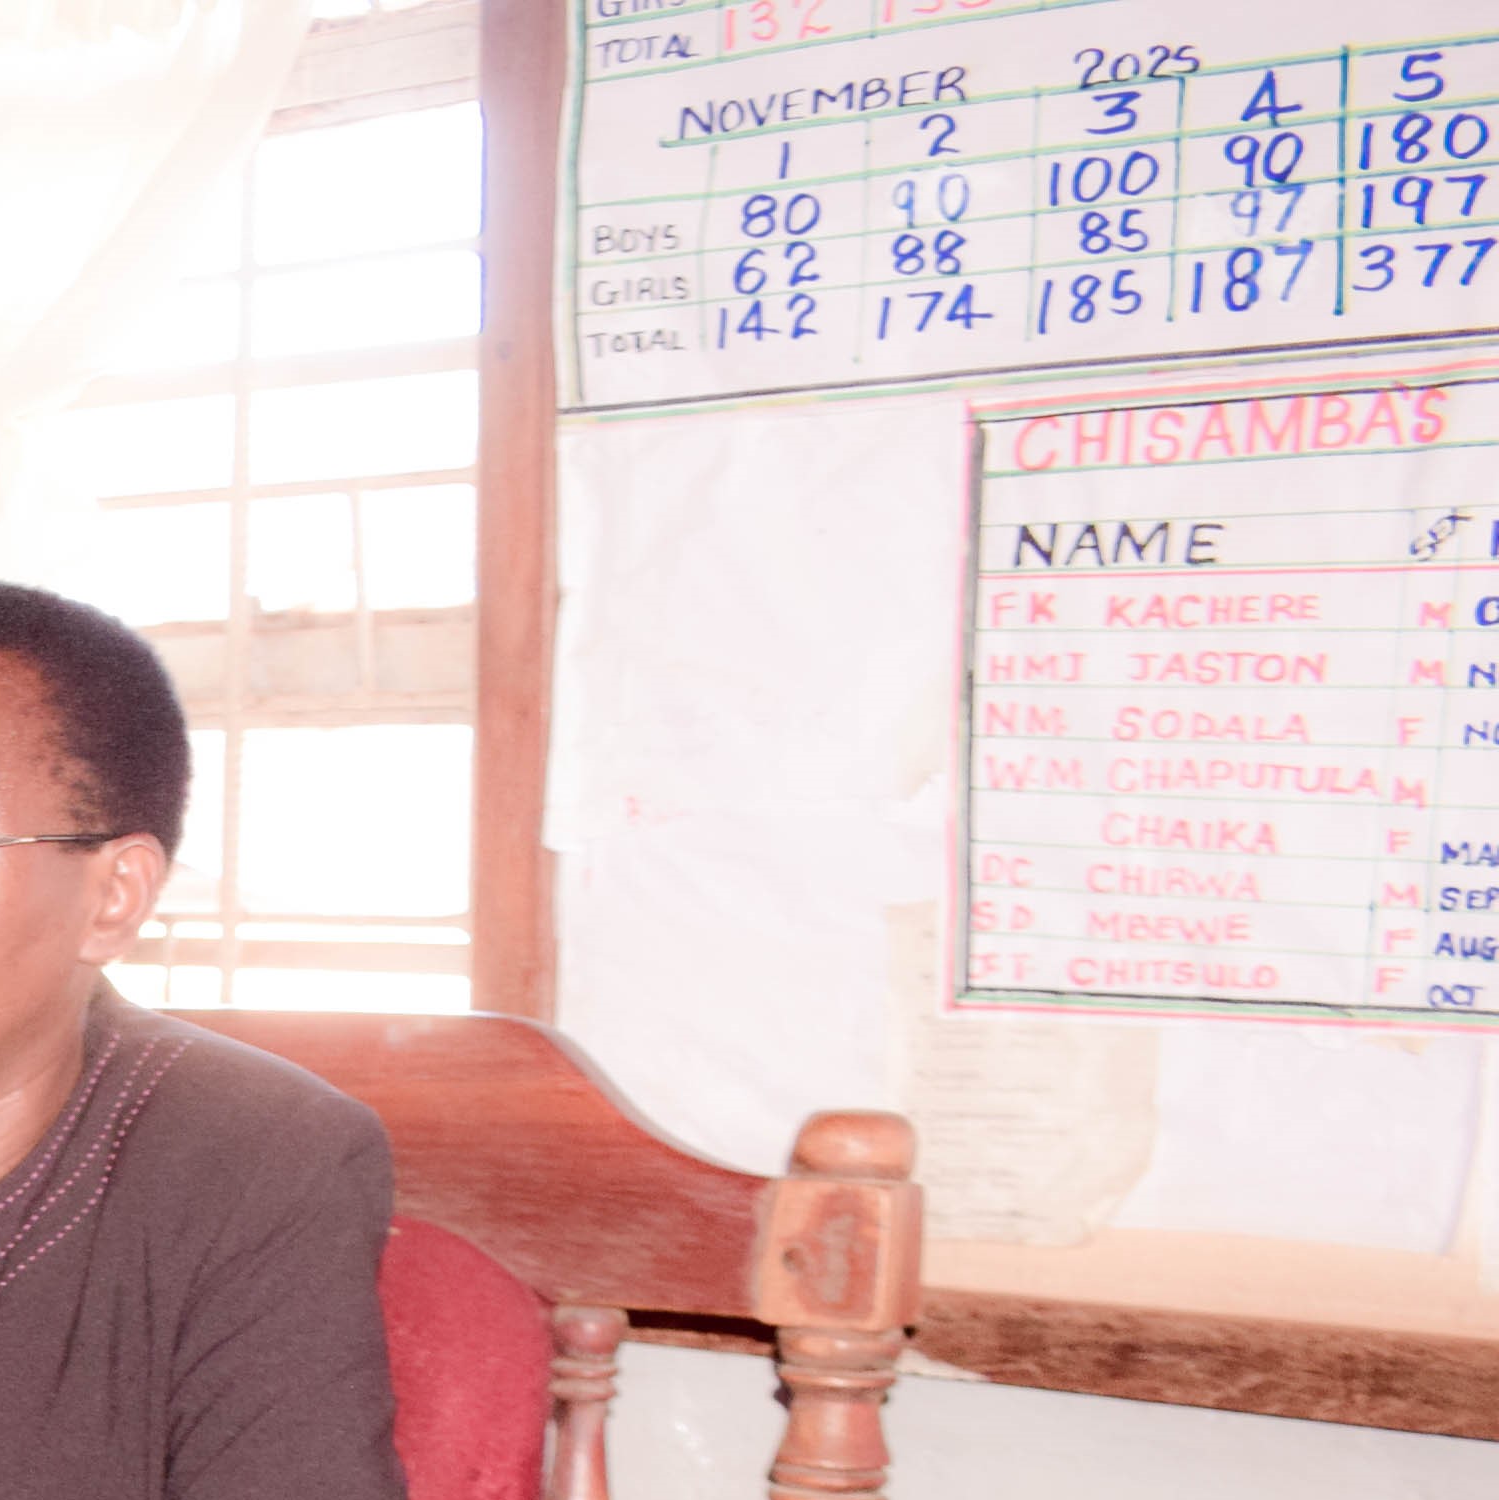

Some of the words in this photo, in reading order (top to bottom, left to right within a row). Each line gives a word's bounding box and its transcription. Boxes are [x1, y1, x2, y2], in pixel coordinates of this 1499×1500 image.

[595, 33, 699, 67] TOTAL
[679, 66, 968, 140] NOVEMBER
[1072, 44, 1201, 91] 2025
[778, 141, 791, 180] 1
[919, 113, 961, 158] 2
[1084, 90, 1144, 135] 3
[1239, 70, 1303, 129] 4
[1391, 51, 1446, 103] 5
[592, 223, 681, 256] BOYS
[741, 193, 822, 239] 80
[892, 173, 971, 230] 90
[1049, 150, 1160, 207] 100
[1223, 130, 1305, 187] 90
[1358, 111, 1491, 171] 180
[591, 276, 691, 307] GIRLS
[732, 240, 822, 296] 62
[890, 229, 968, 276] 88
[1078, 207, 1150, 255] 85
[1229, 182, 1307, 238] 97
[1360, 172, 1489, 230] 197
[587, 328, 688, 359] TOTAL
[716, 293, 819, 350] 142
[877, 283, 995, 341] 174
[1036, 268, 1144, 336] 185
[1189, 237, 1315, 315] 187
[1351, 236, 1499, 292] 377
[1012, 384, 1451, 472] CHISAMBA'S
[1012, 520, 1226, 568] NAME
[1103, 593, 1324, 629] KACHERE
[1417, 600, 1454, 629] M
[1128, 650, 1330, 687] JASTON
[1408, 657, 1447, 687] M
[1110, 705, 1315, 743] SODALA
[1395, 715, 1425, 747] F
[1105, 755, 1383, 797] CHAPUTULA
[1390, 775, 1429, 811] M
[1100, 808, 1282, 856] CHAIKA
[1386, 827, 1412, 854] F
[1084, 859, 1263, 902] CHIRWA
[1383, 882, 1422, 909] M
[1085, 910, 1253, 946] MBEWE
[1383, 926, 1416, 954] F
[1065, 955, 1281, 991] CHITSULO
[1374, 965, 1406, 994] F
